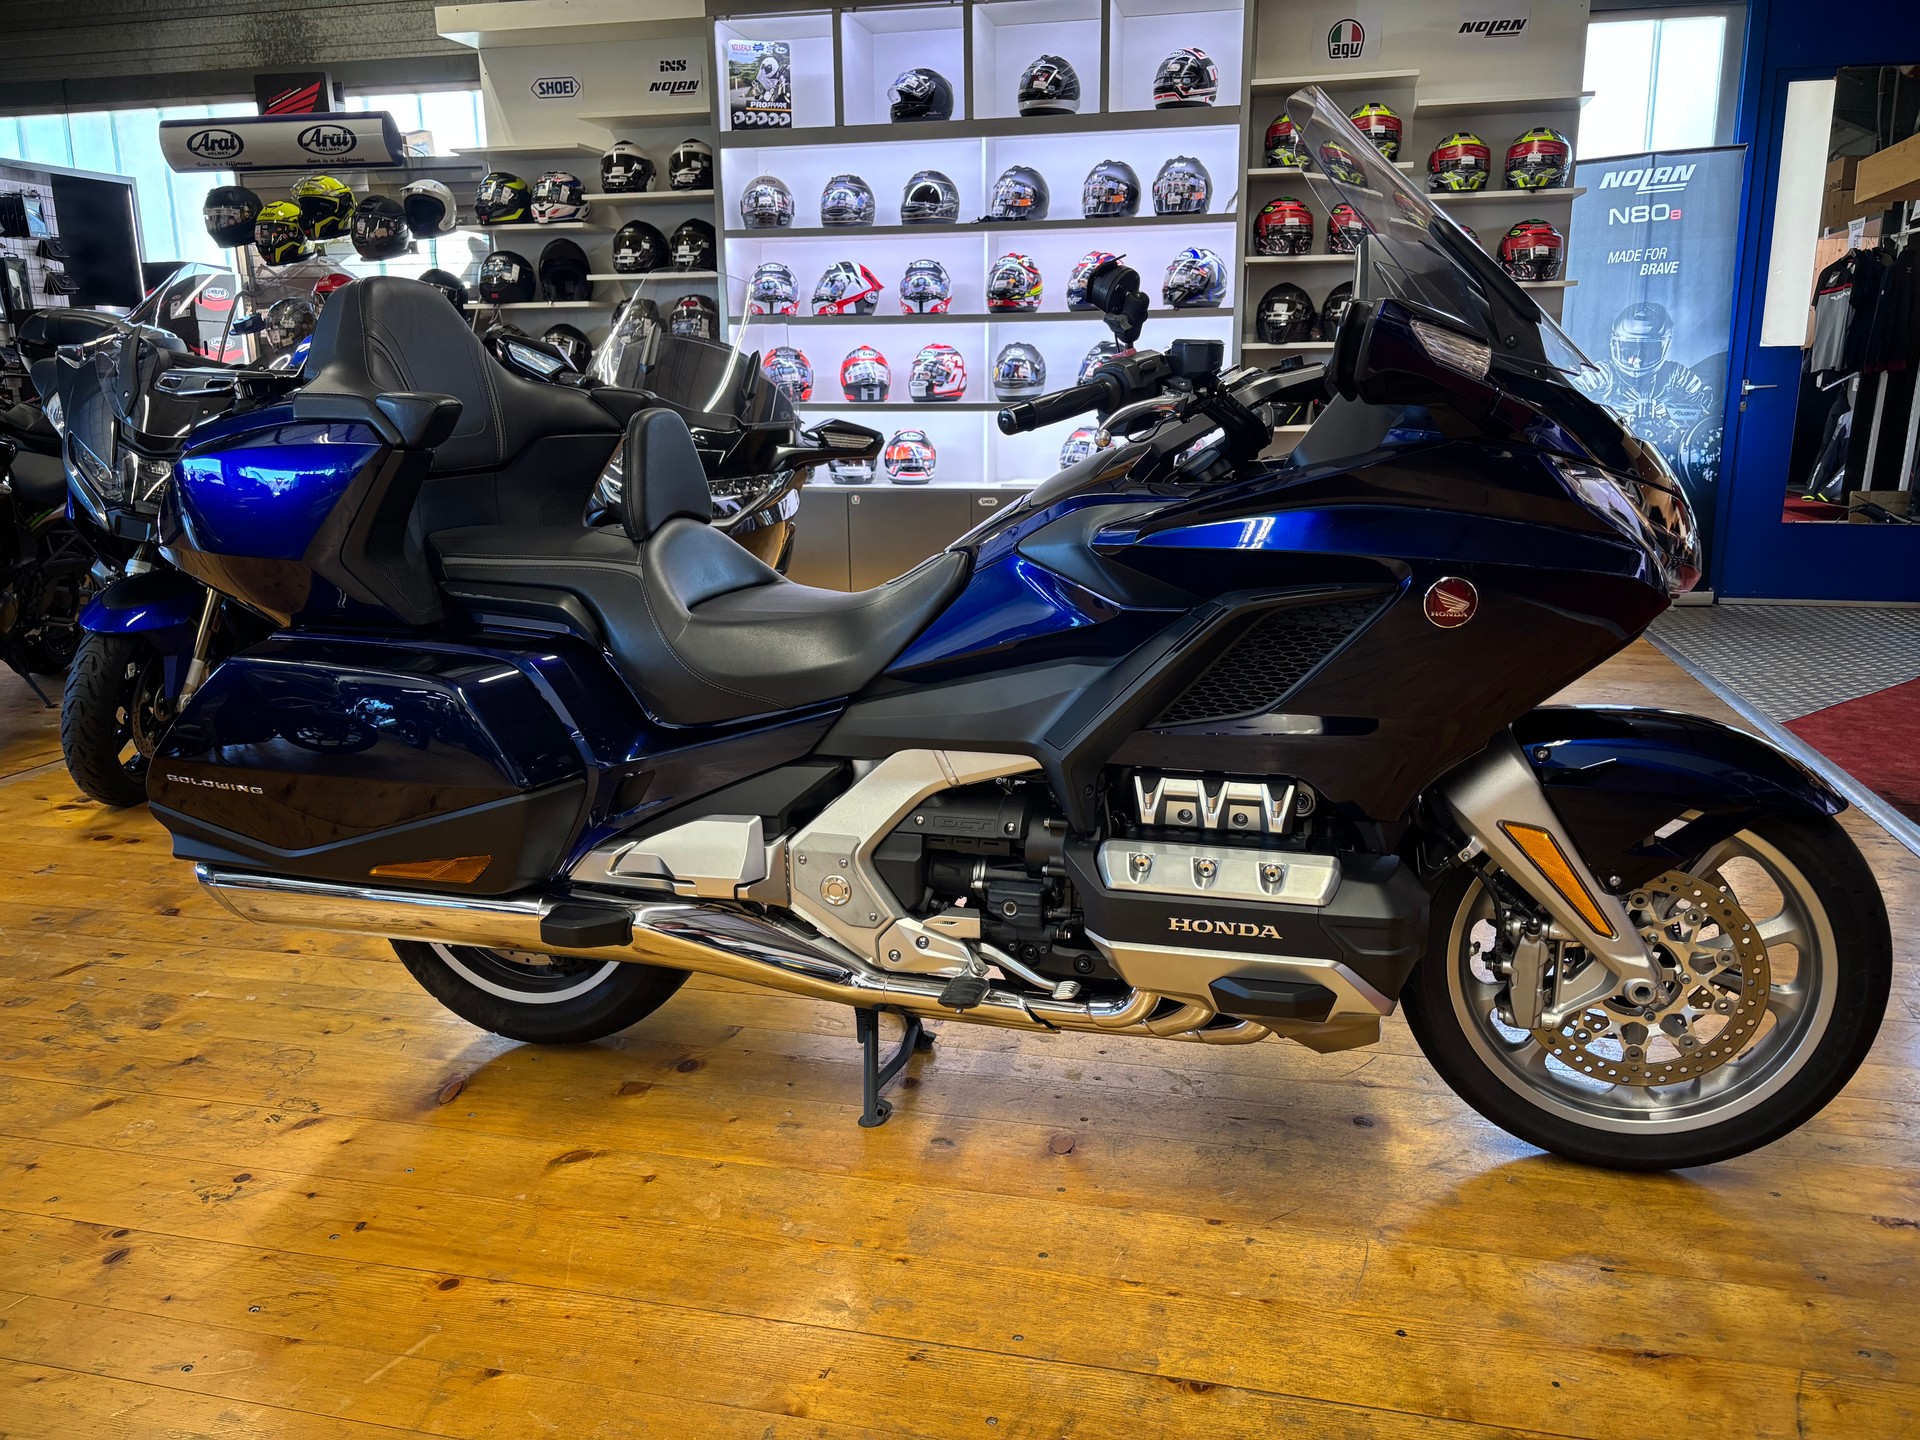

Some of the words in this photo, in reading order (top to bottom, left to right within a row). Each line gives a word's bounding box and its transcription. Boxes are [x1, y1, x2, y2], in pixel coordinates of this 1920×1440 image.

[1458, 19, 1528, 37] NOLAN
[1332, 42, 1360, 58] agv
[538, 80, 574, 95] SHOEI
[649, 80, 700, 96] NOLAN
[192, 133, 238, 152] Arai
[303, 128, 350, 147] Arai
[1599, 164, 1697, 192] NOLAN
[1607, 249, 1643, 264] MADE
[1644, 247, 1668, 261] FOR
[1639, 261, 1680, 276] BRAVE
[166, 773, 264, 795] GOLDWING
[940, 819, 992, 830] DCT
[1168, 917, 1283, 939] HONDA
